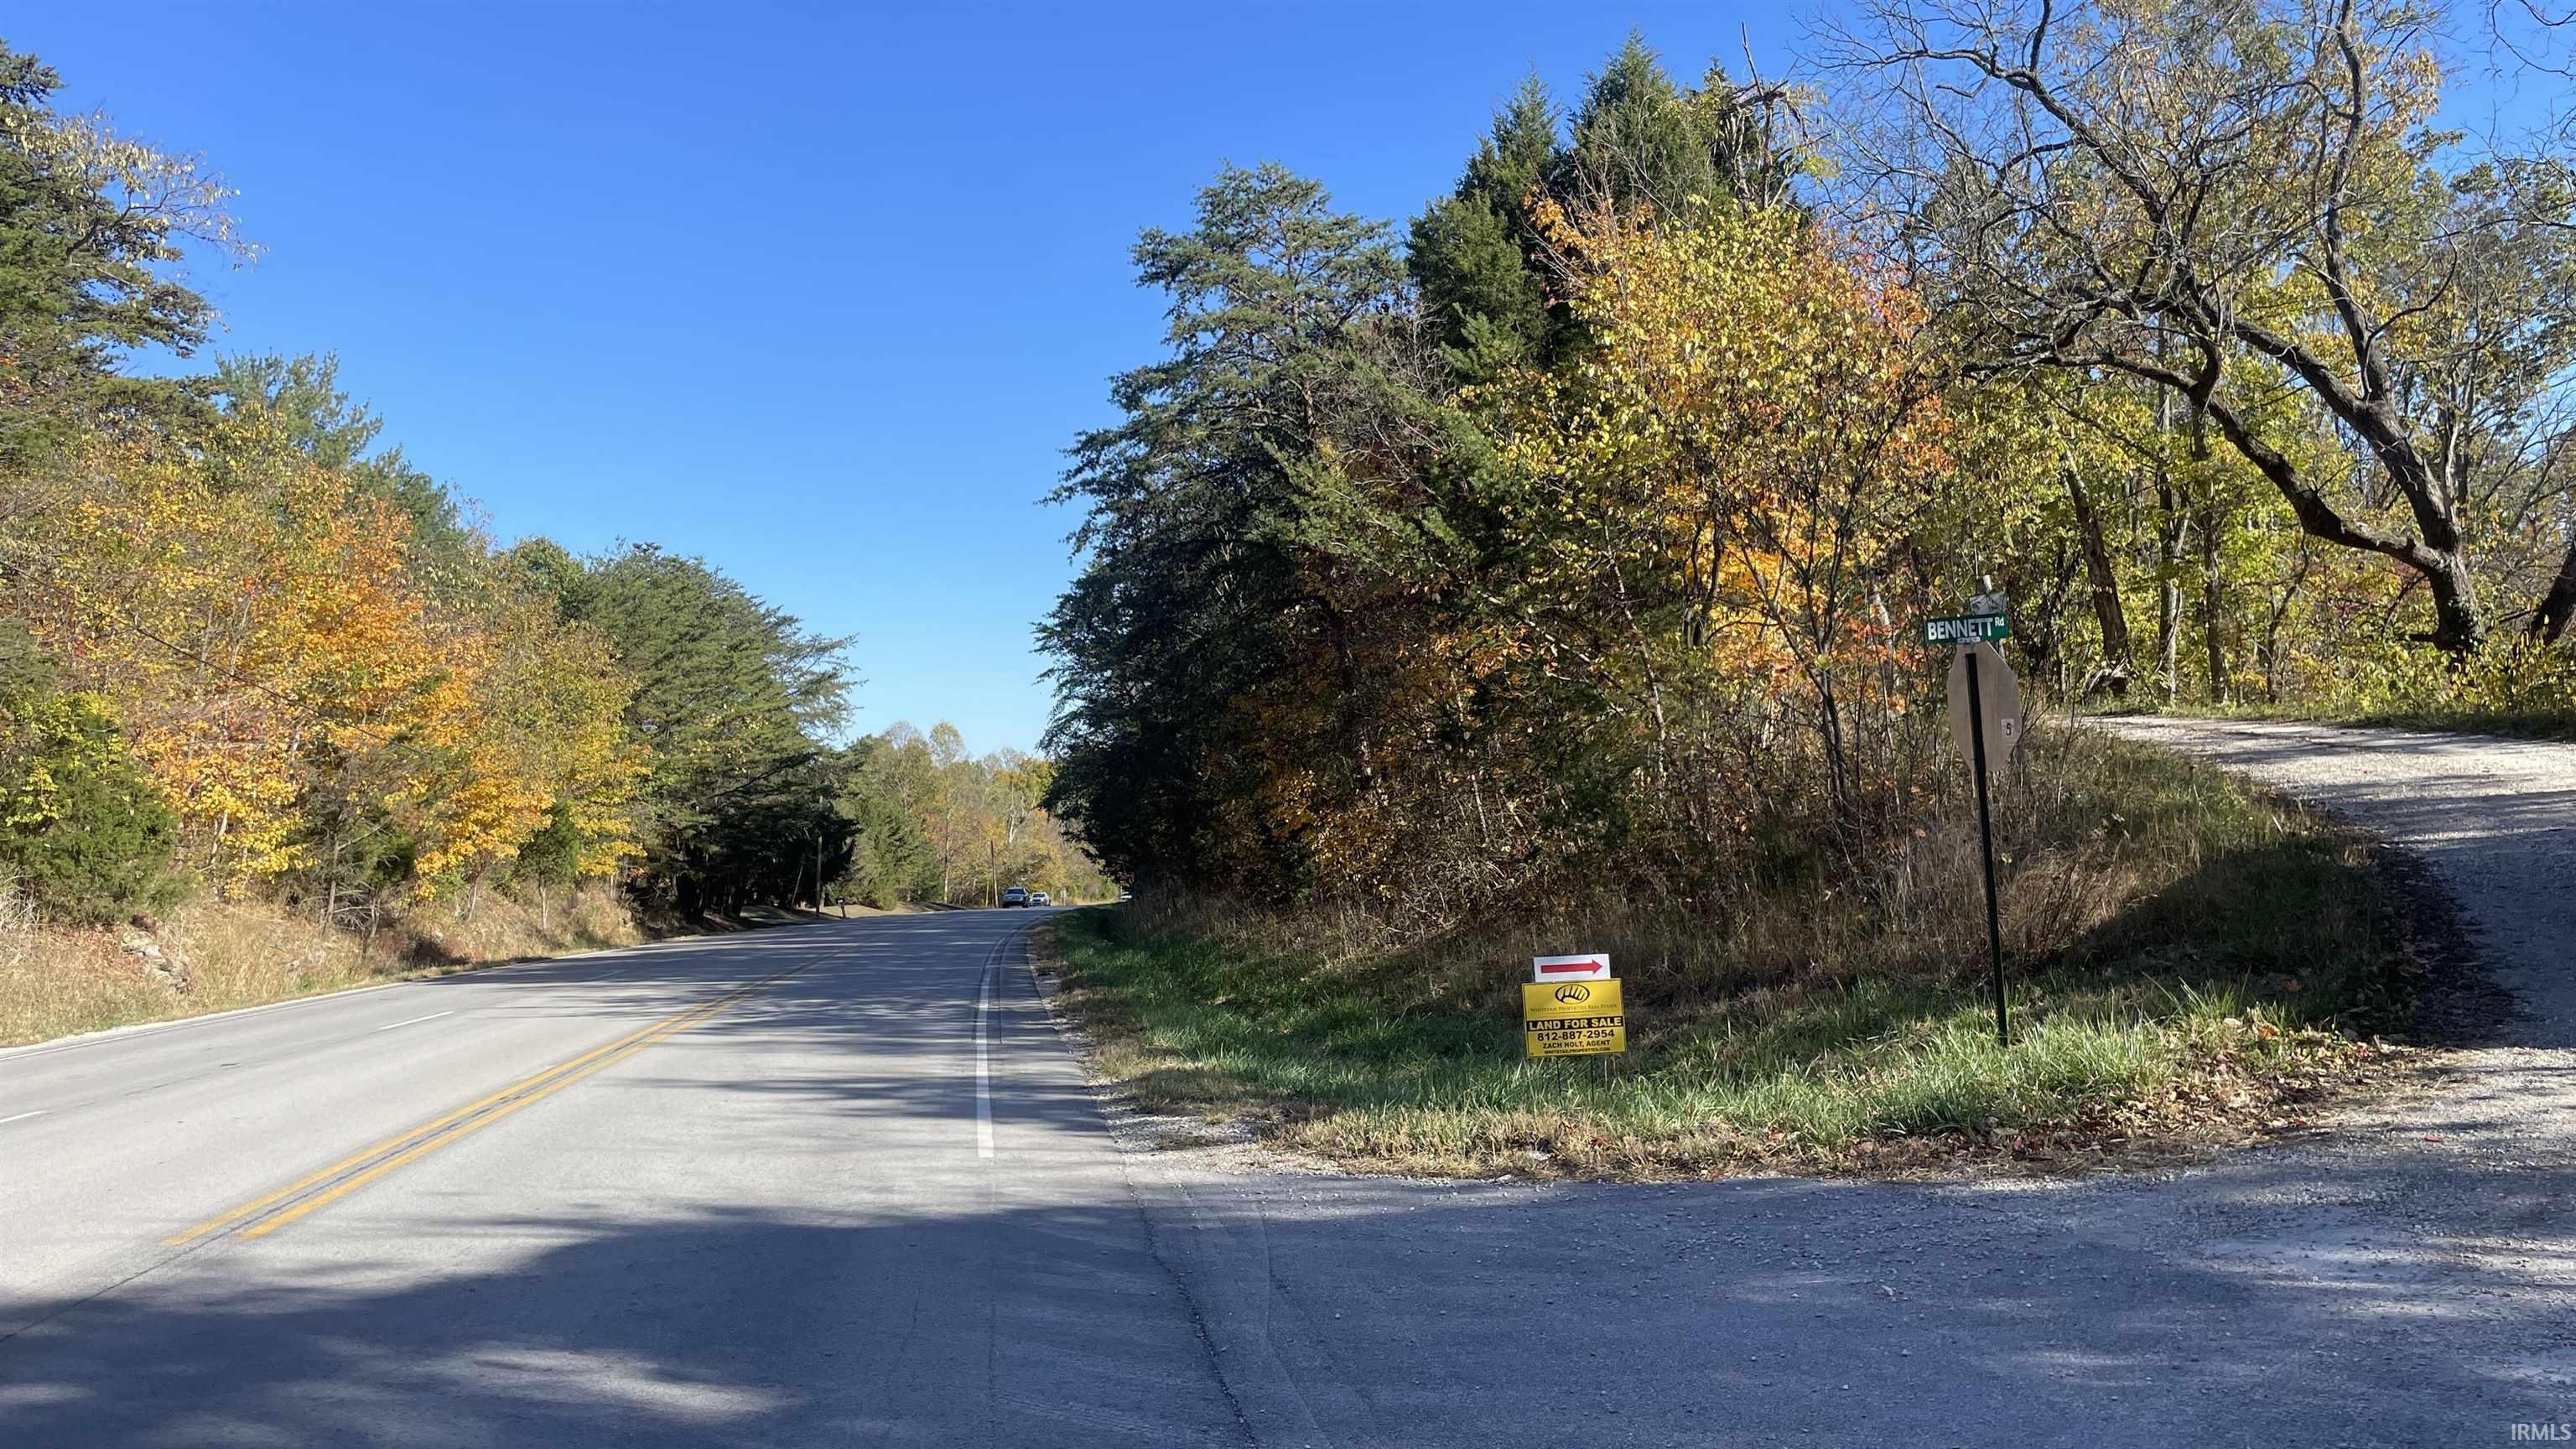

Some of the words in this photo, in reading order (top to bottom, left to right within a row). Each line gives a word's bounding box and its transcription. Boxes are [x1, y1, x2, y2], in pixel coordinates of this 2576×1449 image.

[1927, 618, 1993, 640] BENNETT
[1995, 617, 2004, 626] Rd
[1529, 1021, 1561, 1031] LAND
[1565, 1019, 1588, 1028] FOR
[1591, 1017, 1622, 1027] SALE
[1537, 1030, 1615, 1041] 812-887-2954
